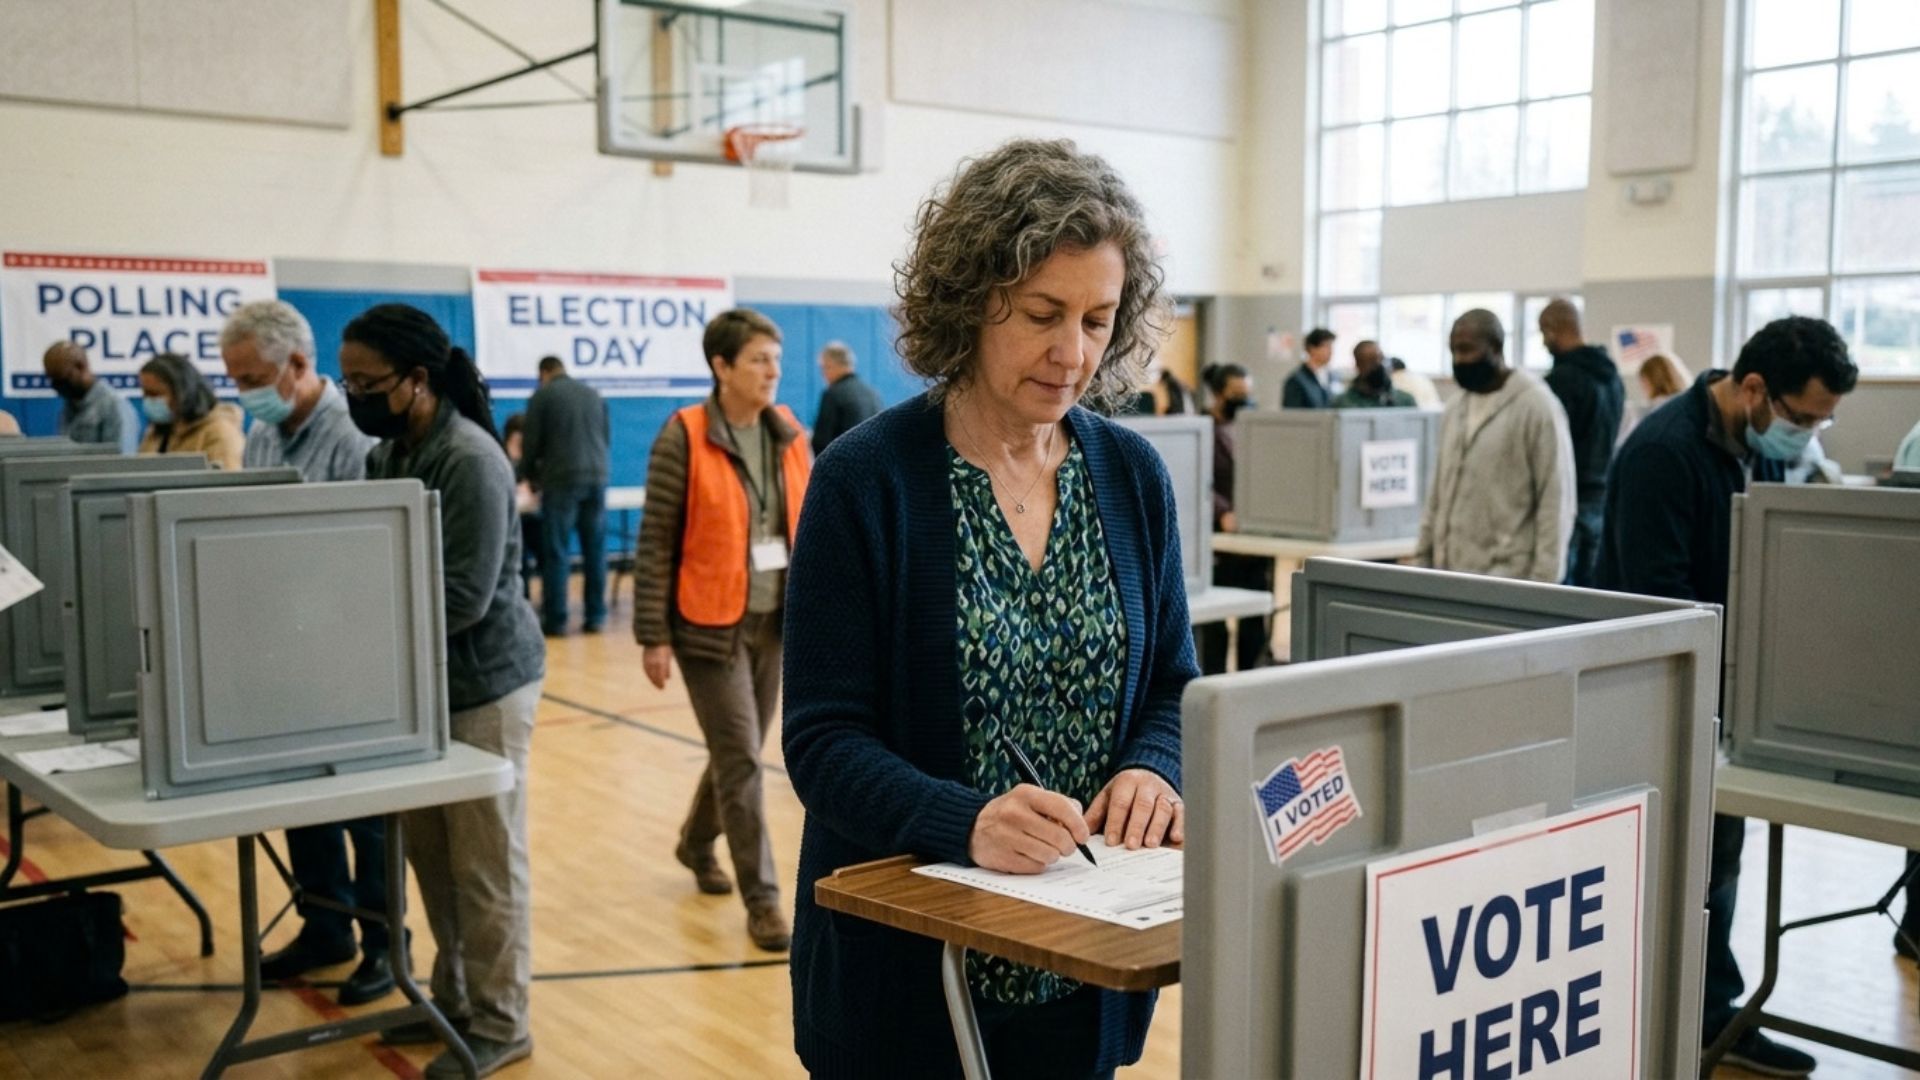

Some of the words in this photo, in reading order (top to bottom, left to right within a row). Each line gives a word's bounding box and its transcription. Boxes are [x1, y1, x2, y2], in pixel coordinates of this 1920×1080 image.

[38, 283, 241, 318] POLLING
[507, 295, 706, 328] ELECTION
[70, 328, 220, 360] PLACE
[573, 337, 650, 367] DAY
[1369, 454, 1407, 470] VOTE
[1369, 477, 1407, 493] HERE
[1275, 818, 1281, 836] I
[1285, 775, 1344, 826] VOTED
[1421, 865, 1606, 996] VOTE
[1418, 970, 1602, 1080] HERE
